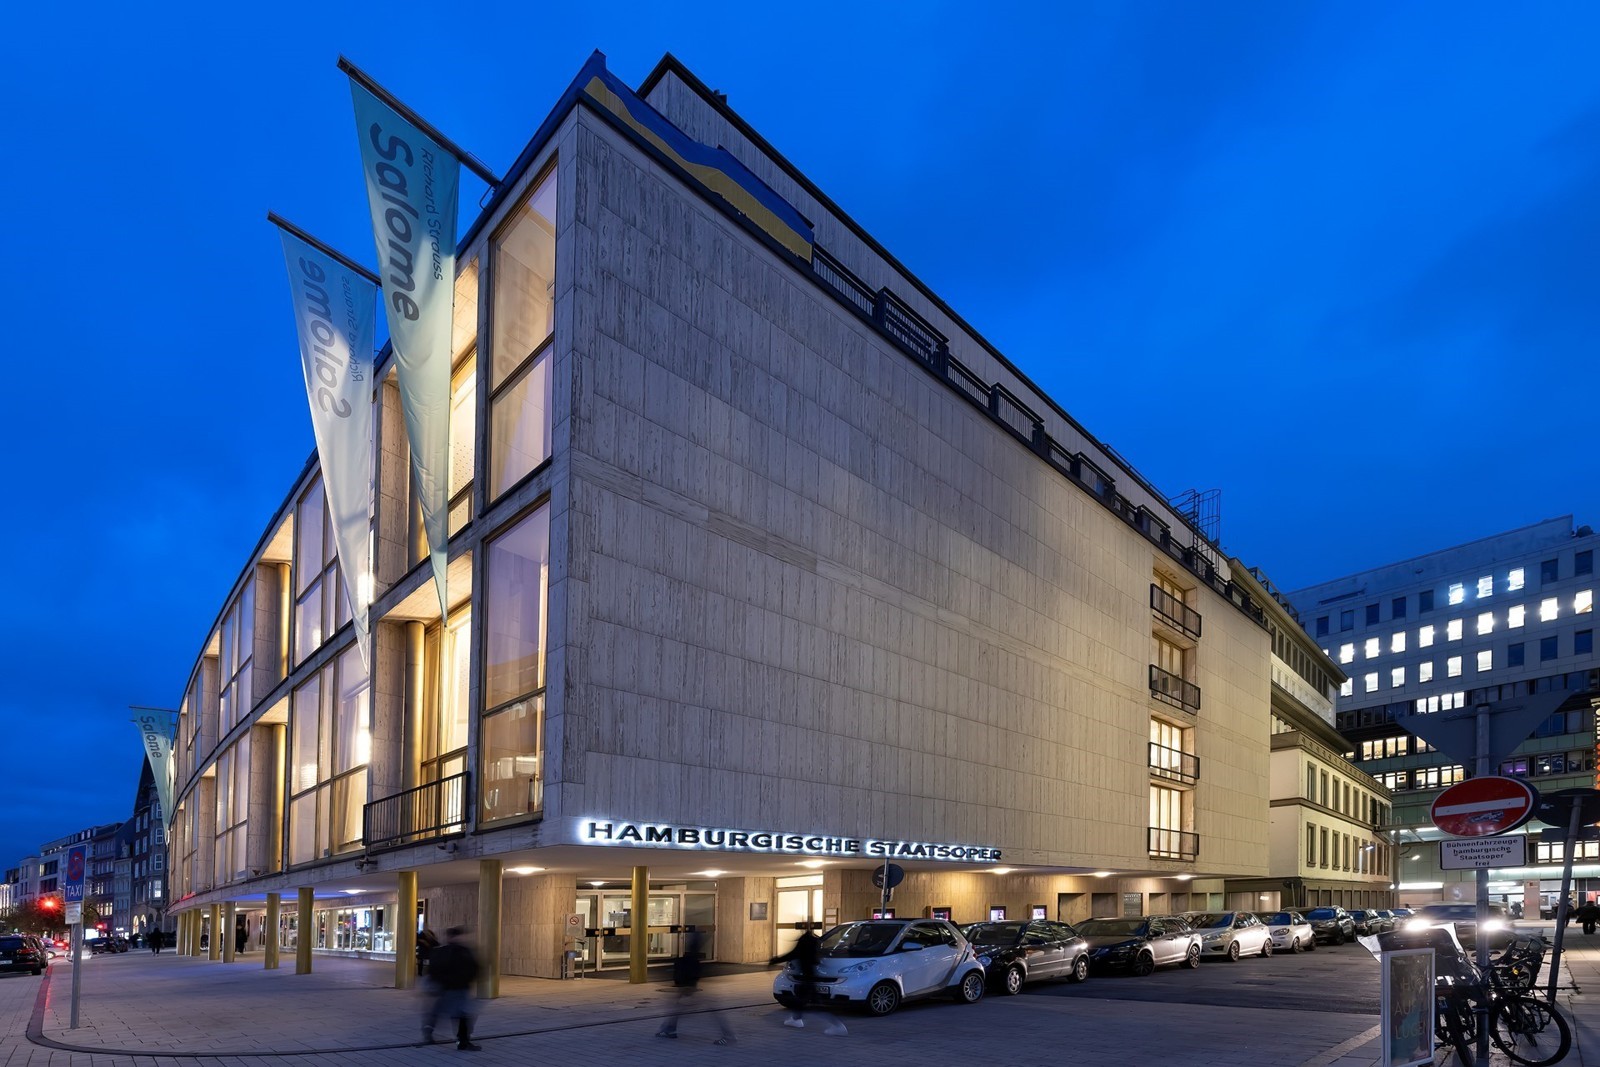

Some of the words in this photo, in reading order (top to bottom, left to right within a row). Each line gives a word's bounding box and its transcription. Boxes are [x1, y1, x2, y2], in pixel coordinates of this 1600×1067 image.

[421, 147, 439, 214] Richard
[370, 122, 419, 321] Salome
[428, 215, 443, 281] Strauss
[140, 715, 162, 758] Salome
[588, 822, 860, 853] HAMBURGISCHE
[870, 841, 1002, 860] STAATSOPER
[1446, 839, 1518, 848] Bühnenfahrzeuge
[1460, 853, 1504, 861] Staatsoper
[66, 884, 82, 897] TAXI
